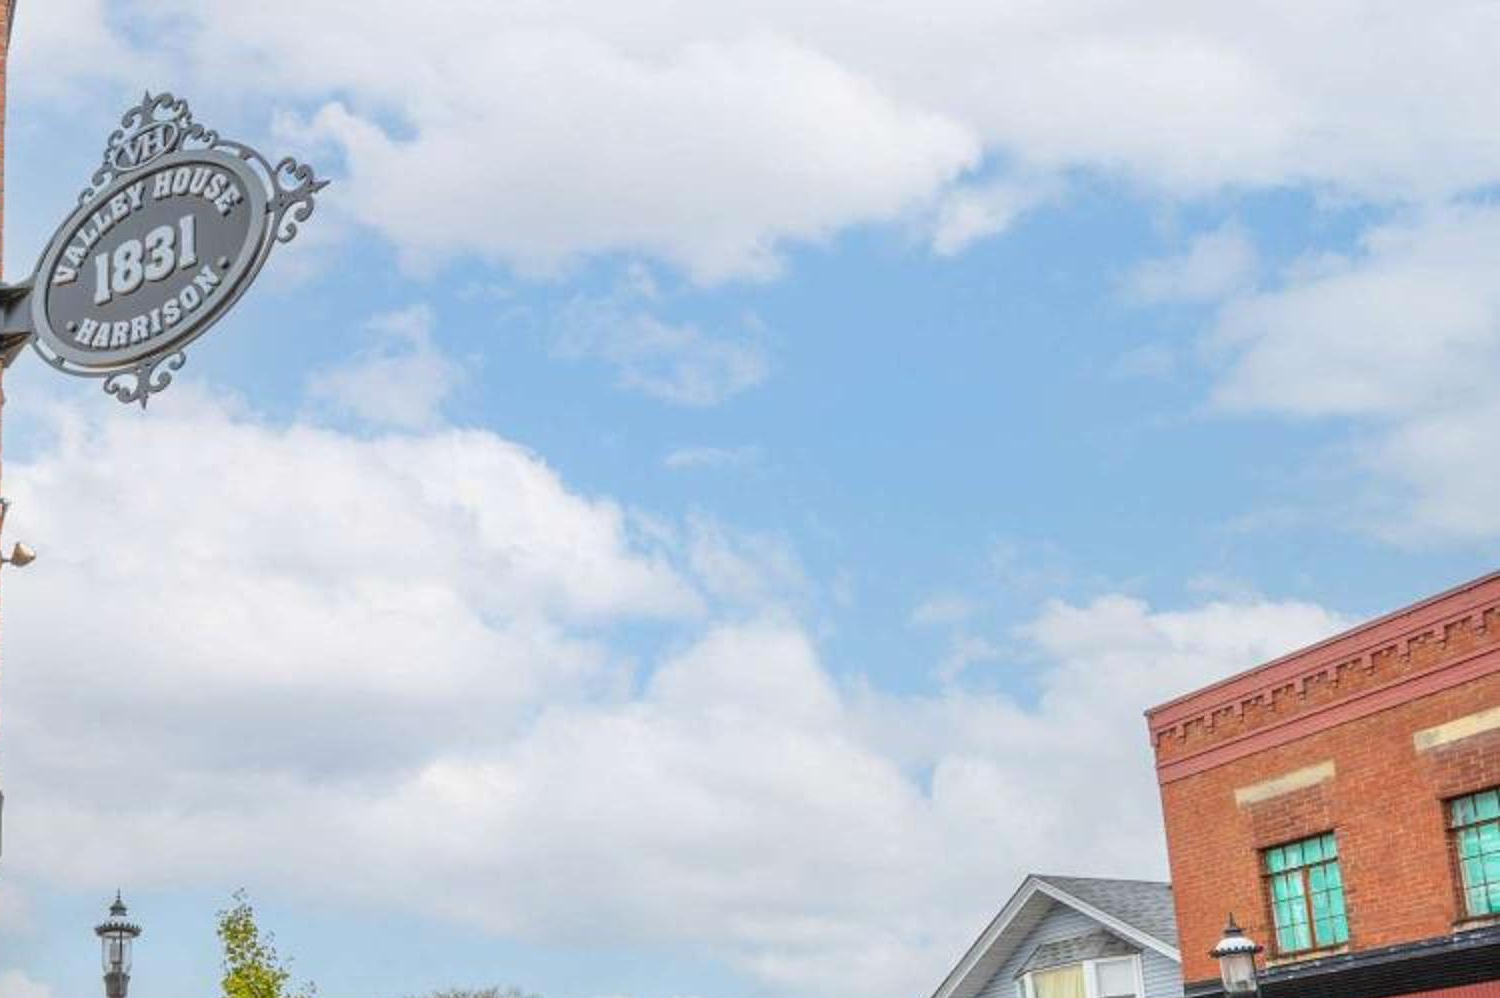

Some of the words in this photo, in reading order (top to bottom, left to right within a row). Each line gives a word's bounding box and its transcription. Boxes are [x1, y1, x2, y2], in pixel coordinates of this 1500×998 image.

[52, 181, 145, 286] VALLEY
[153, 165, 244, 216] HOUSE
[93, 214, 199, 306] 1831
[73, 269, 222, 348] HARRISON
